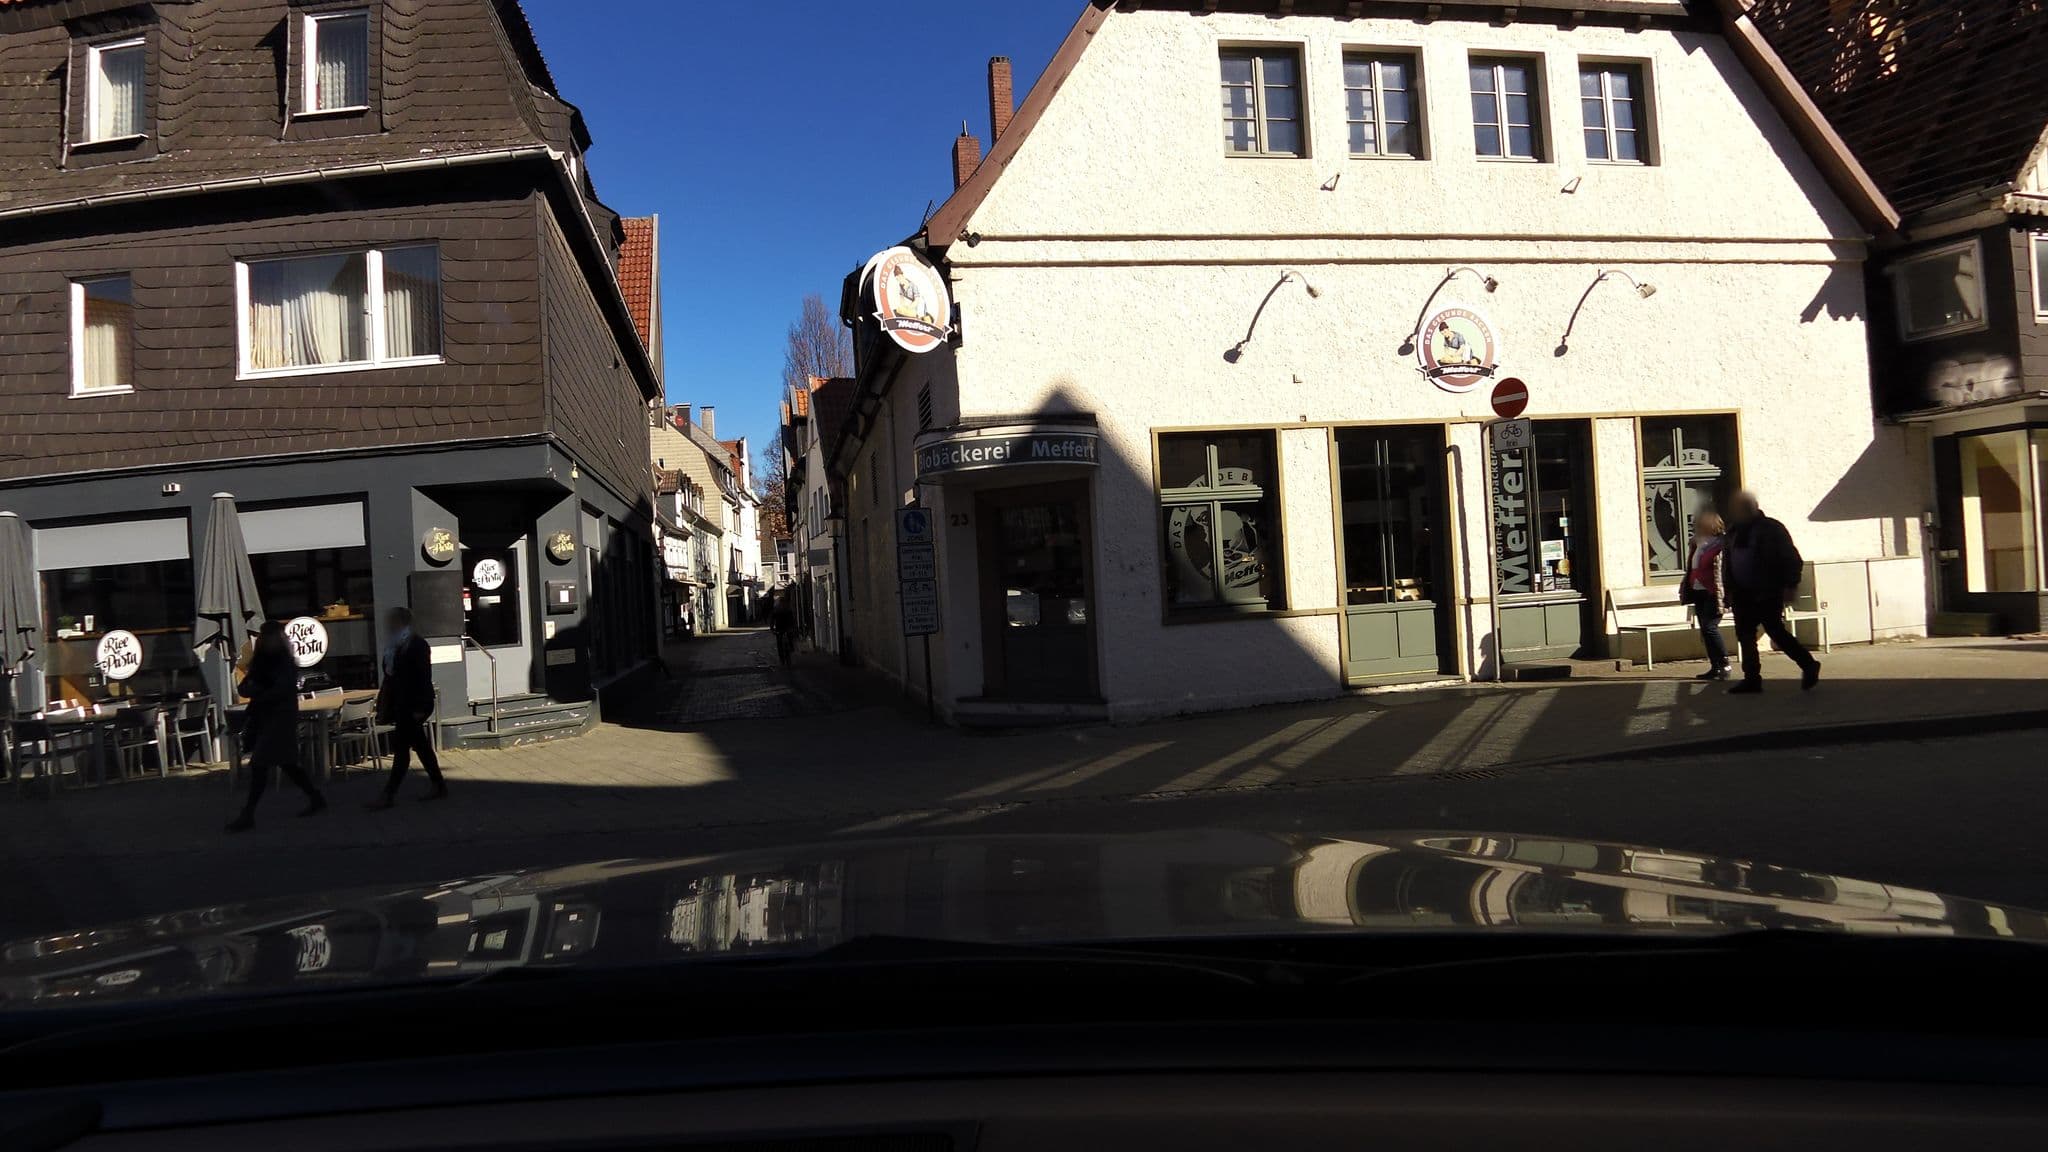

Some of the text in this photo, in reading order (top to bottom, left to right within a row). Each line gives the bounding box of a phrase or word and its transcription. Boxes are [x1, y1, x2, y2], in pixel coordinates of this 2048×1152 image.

[1031, 438, 1095, 459] Meffert
[951, 514, 969, 527] 23
[1499, 447, 1530, 593] Meffer
[1173, 520, 1182, 549] DAS
[290, 623, 315, 641] Rice
[103, 636, 129, 654] Rice
[104, 652, 138, 672] Pasta
